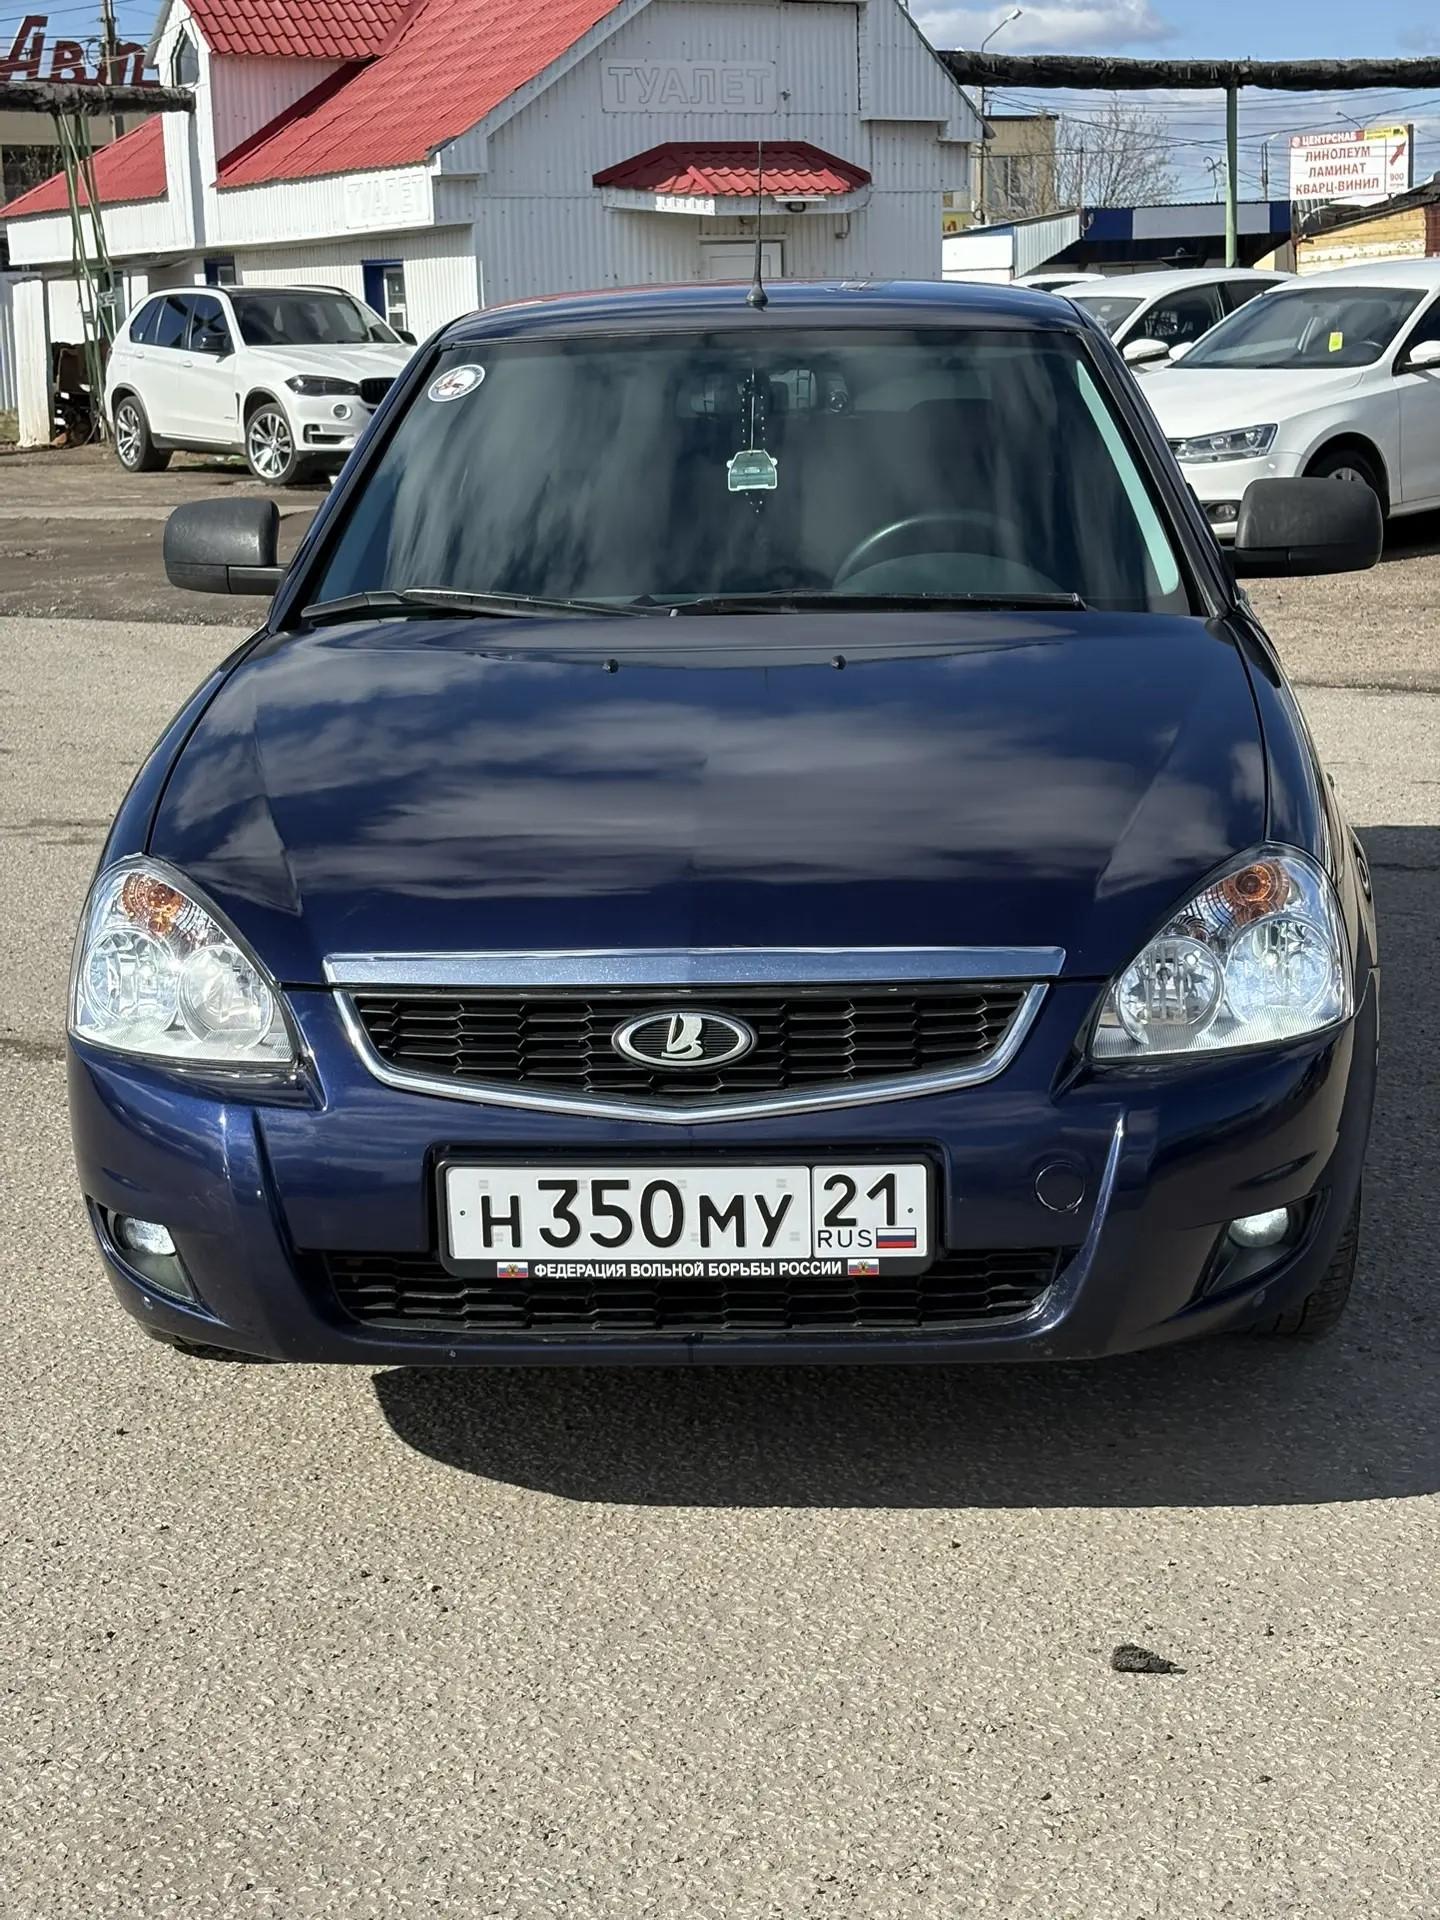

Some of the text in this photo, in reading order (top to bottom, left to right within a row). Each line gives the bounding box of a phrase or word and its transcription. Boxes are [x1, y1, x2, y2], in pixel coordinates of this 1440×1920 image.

[607, 66, 771, 105] ТУАЛЕТ
[1302, 131, 1357, 146] ЦЕНТРСНАБ
[1305, 146, 1371, 162] ЛИНОЛЕУМ
[1308, 162, 1367, 178] ЛАМИНАТ
[1296, 177, 1380, 195] КВАРЦ-ВИНИЛ
[823, 1172, 898, 1228] 21
[817, 1229, 873, 1249] RUS
[534, 1260, 842, 1280] ФЕДЕРАЦИЯ ВОЛЬНОЙ БОРЬБЫ РОССИИ
